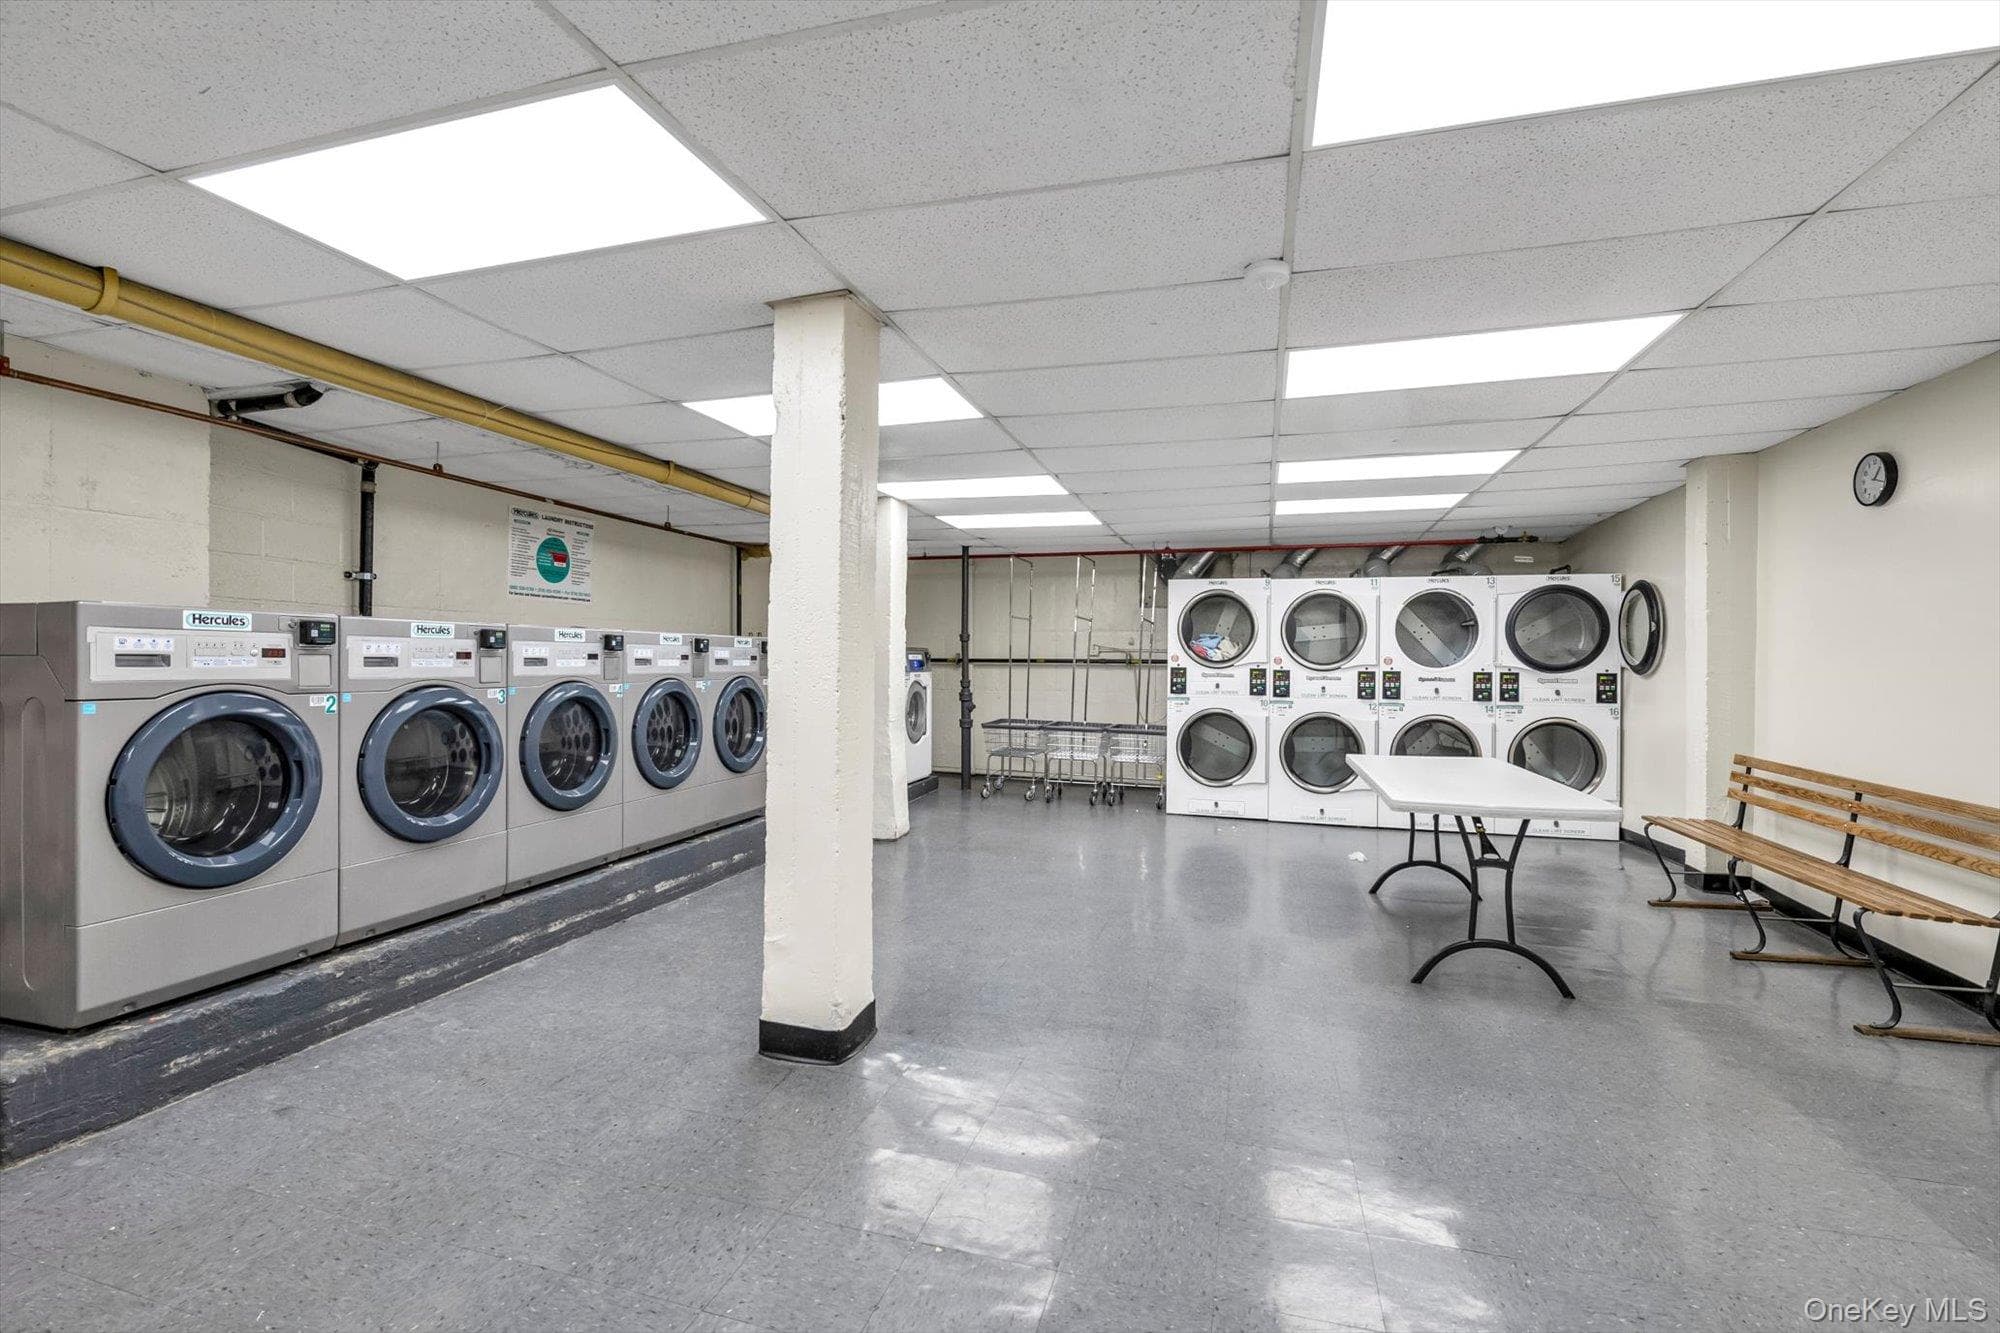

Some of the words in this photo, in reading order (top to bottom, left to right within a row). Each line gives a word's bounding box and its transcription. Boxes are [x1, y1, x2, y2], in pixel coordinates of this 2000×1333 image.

[1370, 578, 1378, 586] 11
[1486, 577, 1496, 585] 13
[1611, 574, 1620, 583] 15
[192, 613, 246, 626] Hercules
[416, 624, 451, 635] Hercules
[498, 689, 505, 704] 3
[326, 695, 336, 713] 2
[1369, 703, 1378, 711] 12
[1609, 708, 1619, 716] 16
